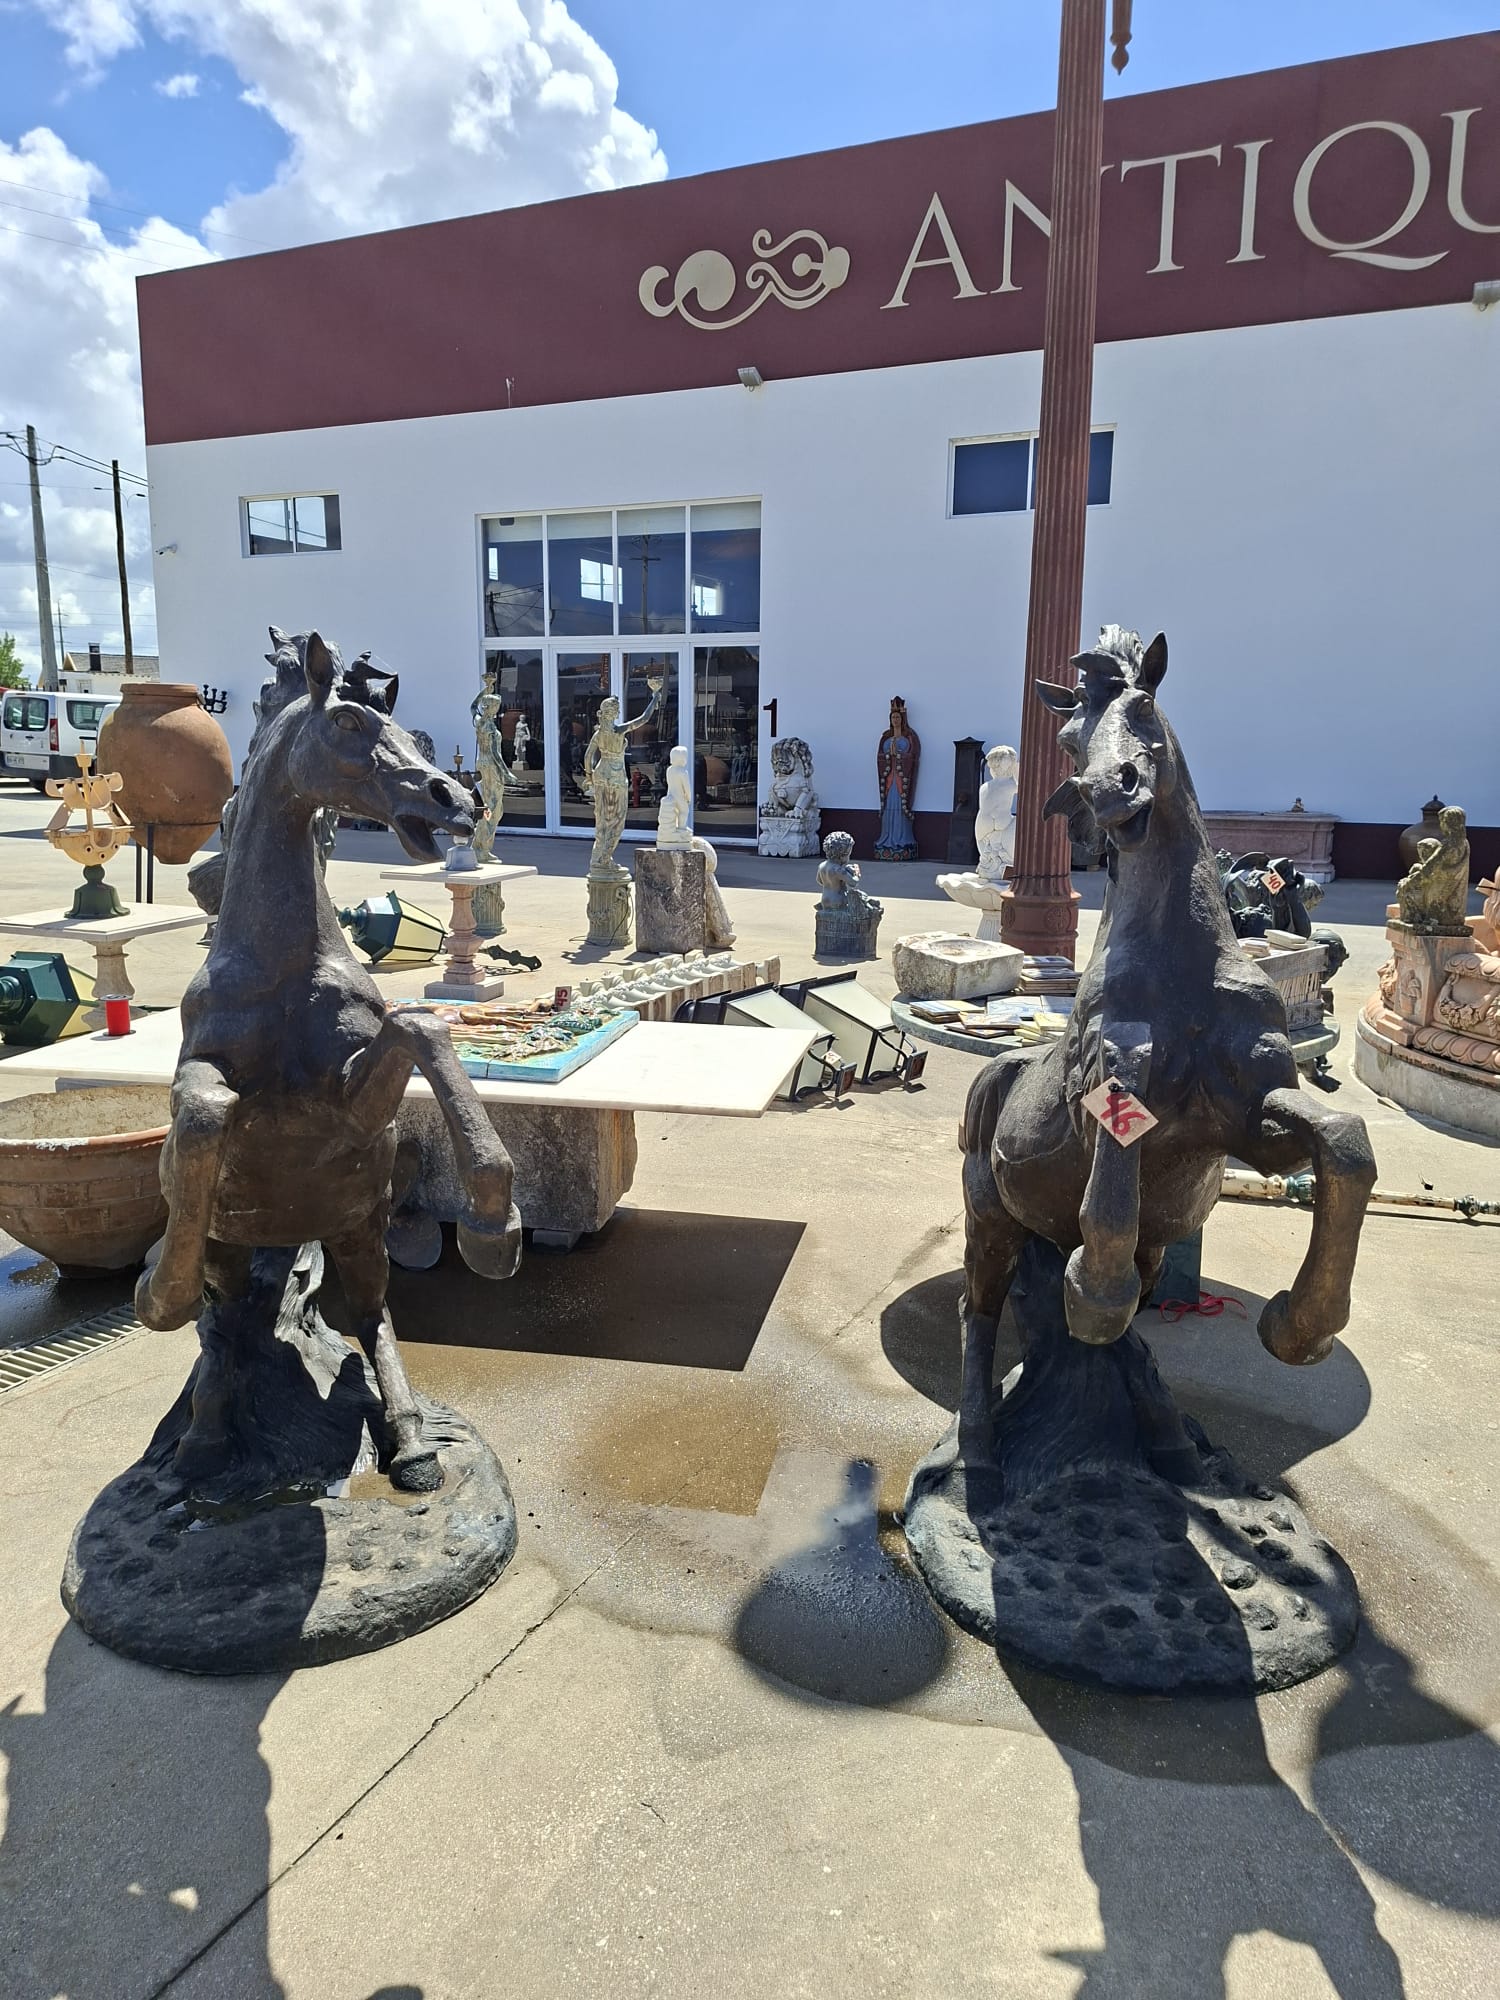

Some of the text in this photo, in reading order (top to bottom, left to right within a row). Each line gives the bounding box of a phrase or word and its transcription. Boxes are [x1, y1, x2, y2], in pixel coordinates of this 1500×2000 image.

[763, 698, 777, 737] 1
[1268, 874, 1281, 889] 40
[557, 989, 568, 1006] 45
[1100, 1092, 1147, 1137] 46
